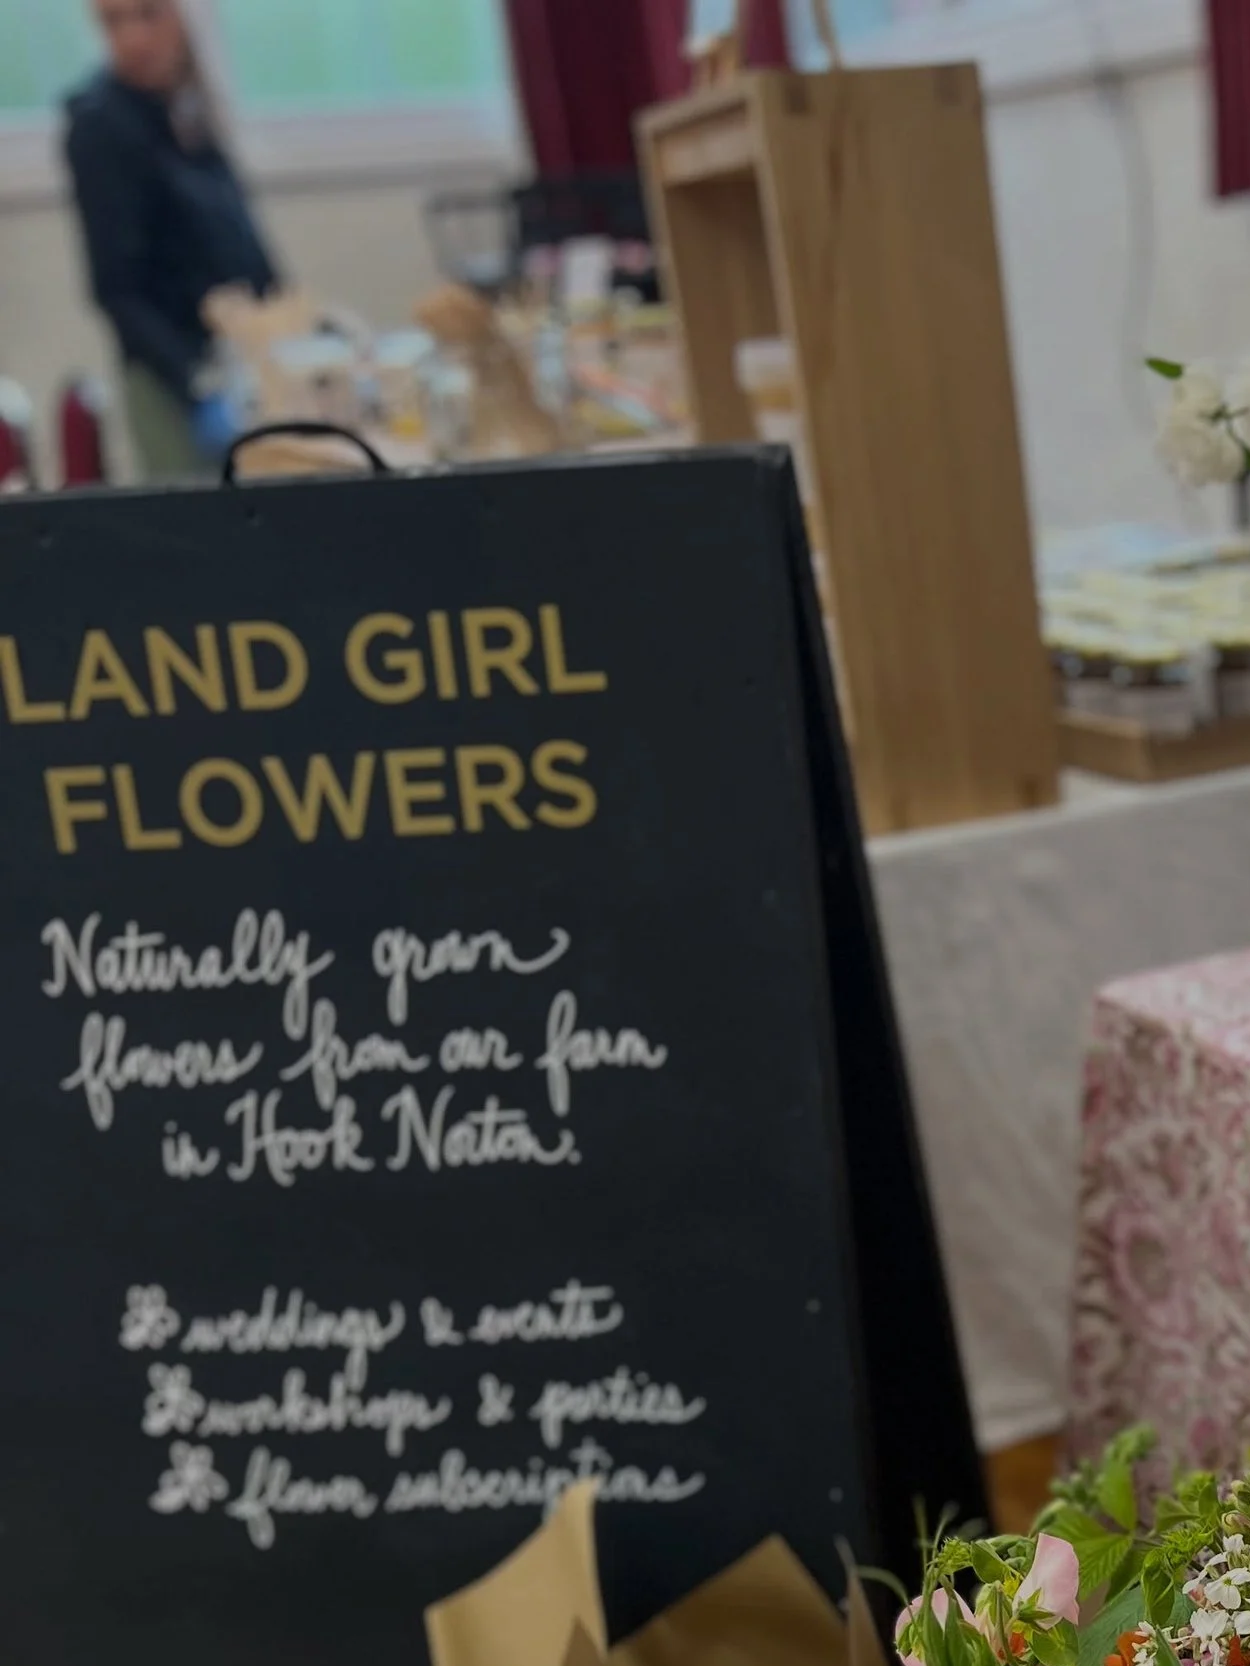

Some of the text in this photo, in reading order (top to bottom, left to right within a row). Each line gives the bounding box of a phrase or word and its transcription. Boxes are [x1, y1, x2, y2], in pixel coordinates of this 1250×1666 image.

[0, 604, 608, 724] LAND GIRL
[44, 739, 598, 855] FLOWERS
[41, 908, 570, 1041] Naturally grown
[60, 990, 668, 1131] flowers from our farm
[161, 1084, 582, 1187] in Hook Norton.
[180, 1278, 624, 1393] weddings & events
[198, 1364, 708, 1458] workshops & parties
[224, 1445, 379, 1551] flower
